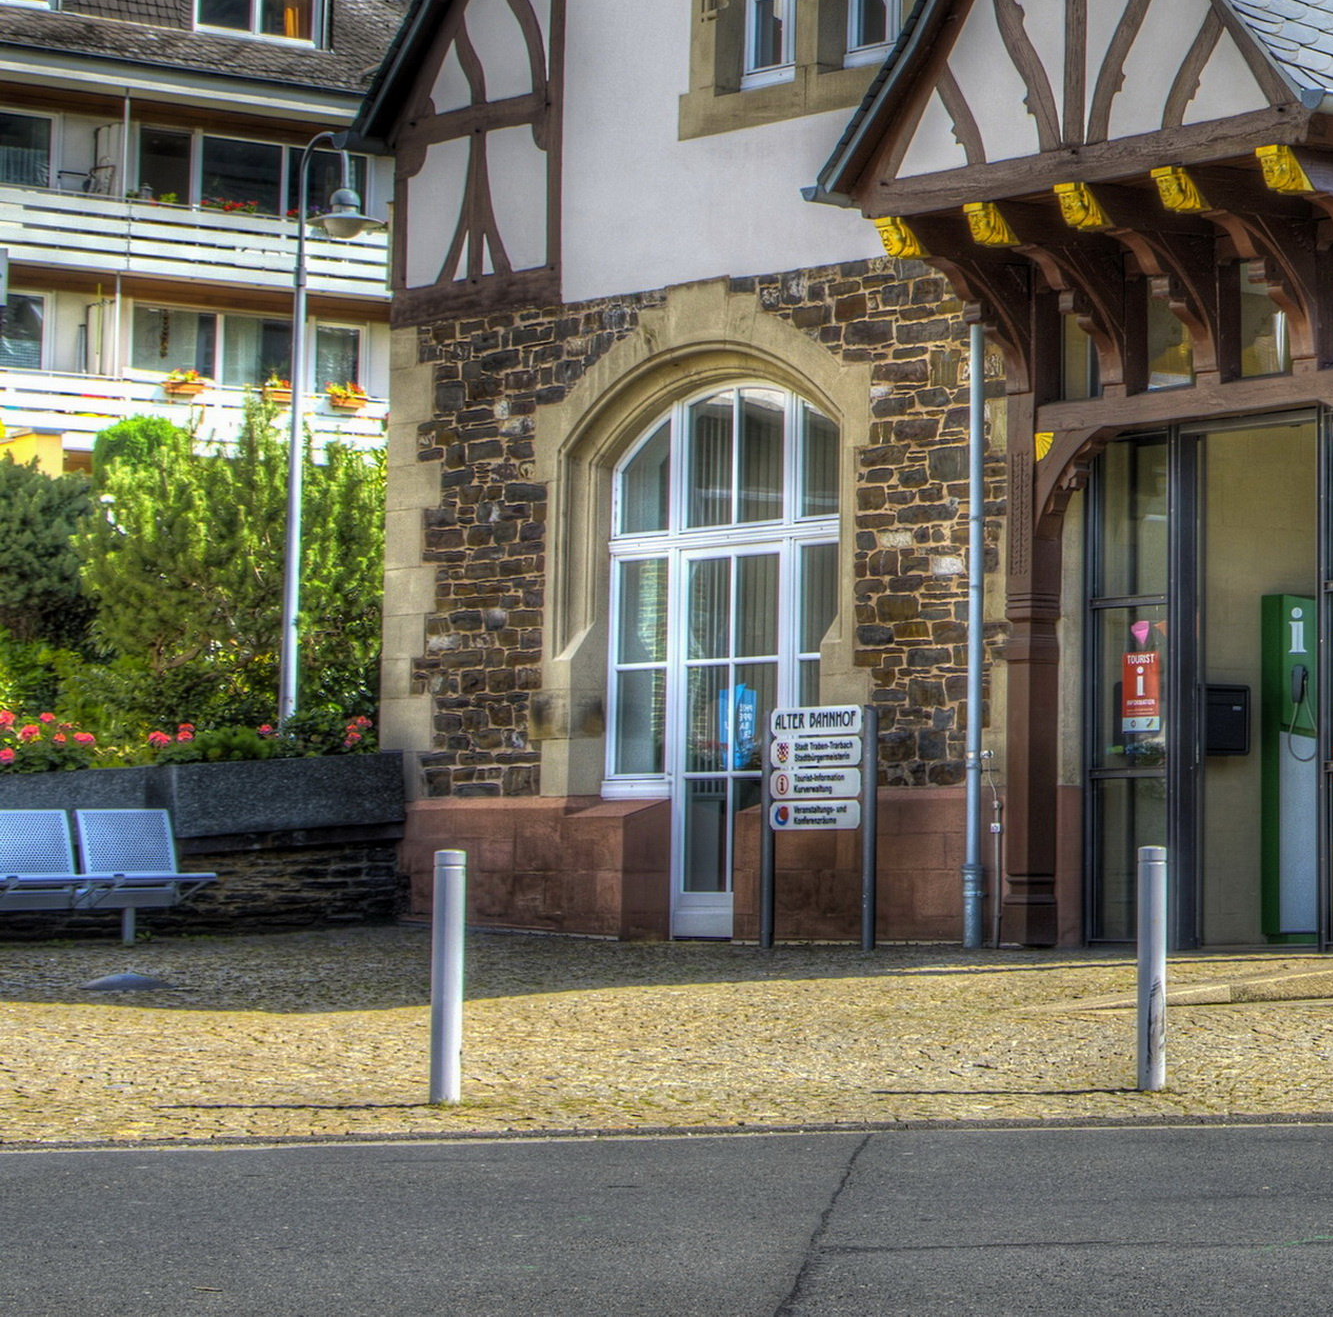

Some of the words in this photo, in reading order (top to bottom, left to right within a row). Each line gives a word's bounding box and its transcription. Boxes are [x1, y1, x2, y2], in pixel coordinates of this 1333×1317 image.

[1127, 653, 1155, 665] TOURIST
[775, 713, 805, 730] ALTER
[809, 710, 857, 728] BAHNHOF
[794, 742, 809, 751] Stadt
[810, 740, 853, 750] Traben-Trarbach
[793, 773, 845, 782] Tourist-Information
[793, 785, 833, 794] Kurverwaltung
[793, 805, 835, 815] Veranstaltungs-
[836, 805, 847, 813] und
[793, 816, 837, 825] Konferenzräume
